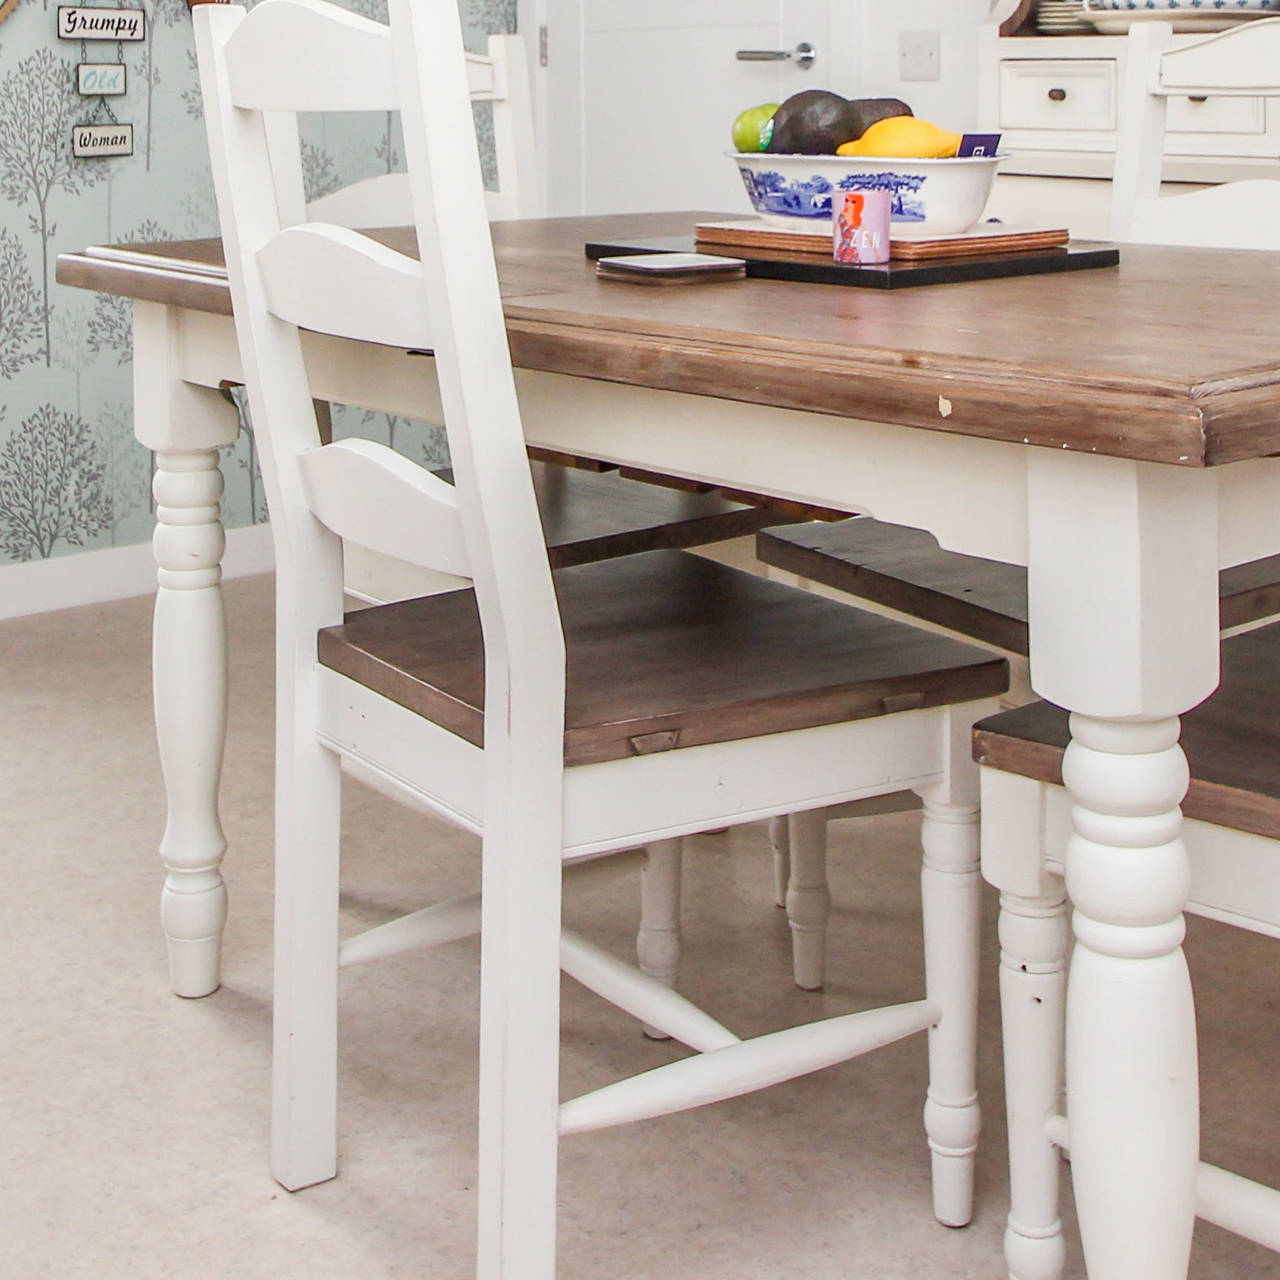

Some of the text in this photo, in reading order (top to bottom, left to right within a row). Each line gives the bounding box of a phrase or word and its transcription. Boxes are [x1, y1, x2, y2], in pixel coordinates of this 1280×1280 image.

[64, 10, 138, 37] Grumpy
[83, 69, 121, 90] Old
[79, 131, 127, 148] Woman
[850, 228, 880, 249] ZEN
